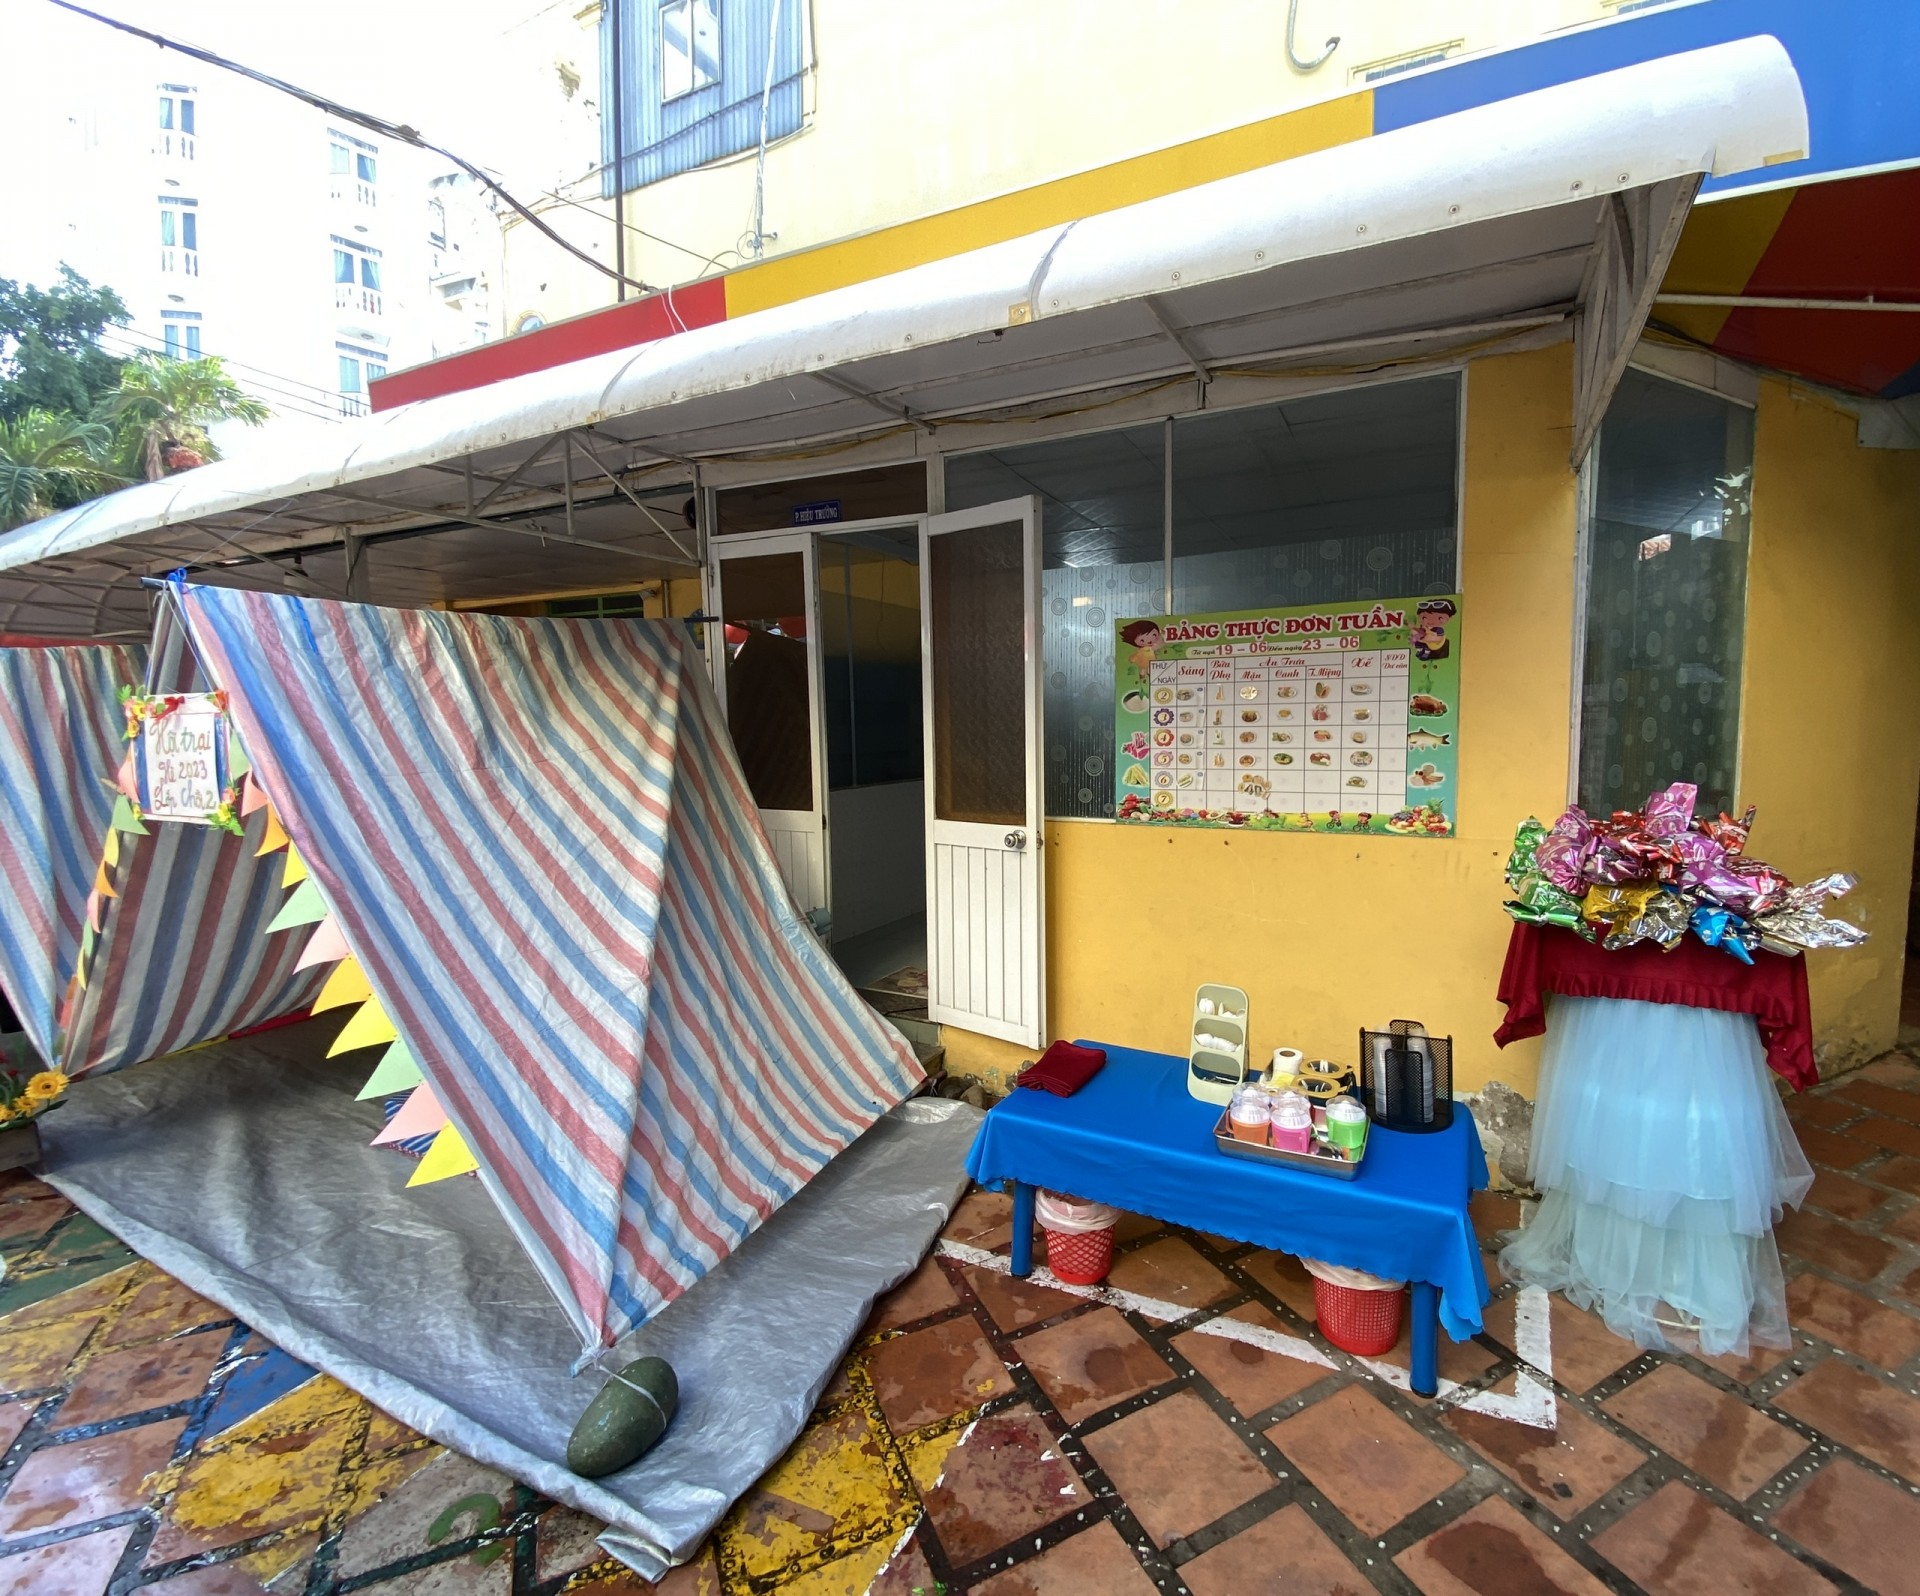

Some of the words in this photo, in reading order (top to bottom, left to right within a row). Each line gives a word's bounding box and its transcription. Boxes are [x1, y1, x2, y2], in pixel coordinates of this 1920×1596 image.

[1166, 620, 1220, 641] BẢNG
[1225, 618, 1280, 639] THỰC
[1285, 615, 1332, 634] ĐƠN
[1337, 606, 1403, 630] TUẦN
[1216, 643, 1233, 655] 19
[1249, 642, 1267, 654] 06
[1302, 639, 1321, 650] 23
[1339, 636, 1359, 649] 06
[1280, 656, 1305, 667] Trưa
[1178, 665, 1205, 677] Sáng
[1210, 669, 1231, 680] Phụ
[1274, 668, 1300, 679] Canh
[1157, 675, 1177, 684] NGÀY
[1160, 692, 1168, 700] 2
[1160, 713, 1167, 721] 3
[149, 717, 180, 757] Hội
[181, 726, 211, 756] trại
[1161, 755, 1168, 763] 5
[179, 759, 208, 780] 2023
[1160, 776, 1167, 784] 6
[205, 790, 217, 810] 2
[1160, 795, 1168, 803] 7
